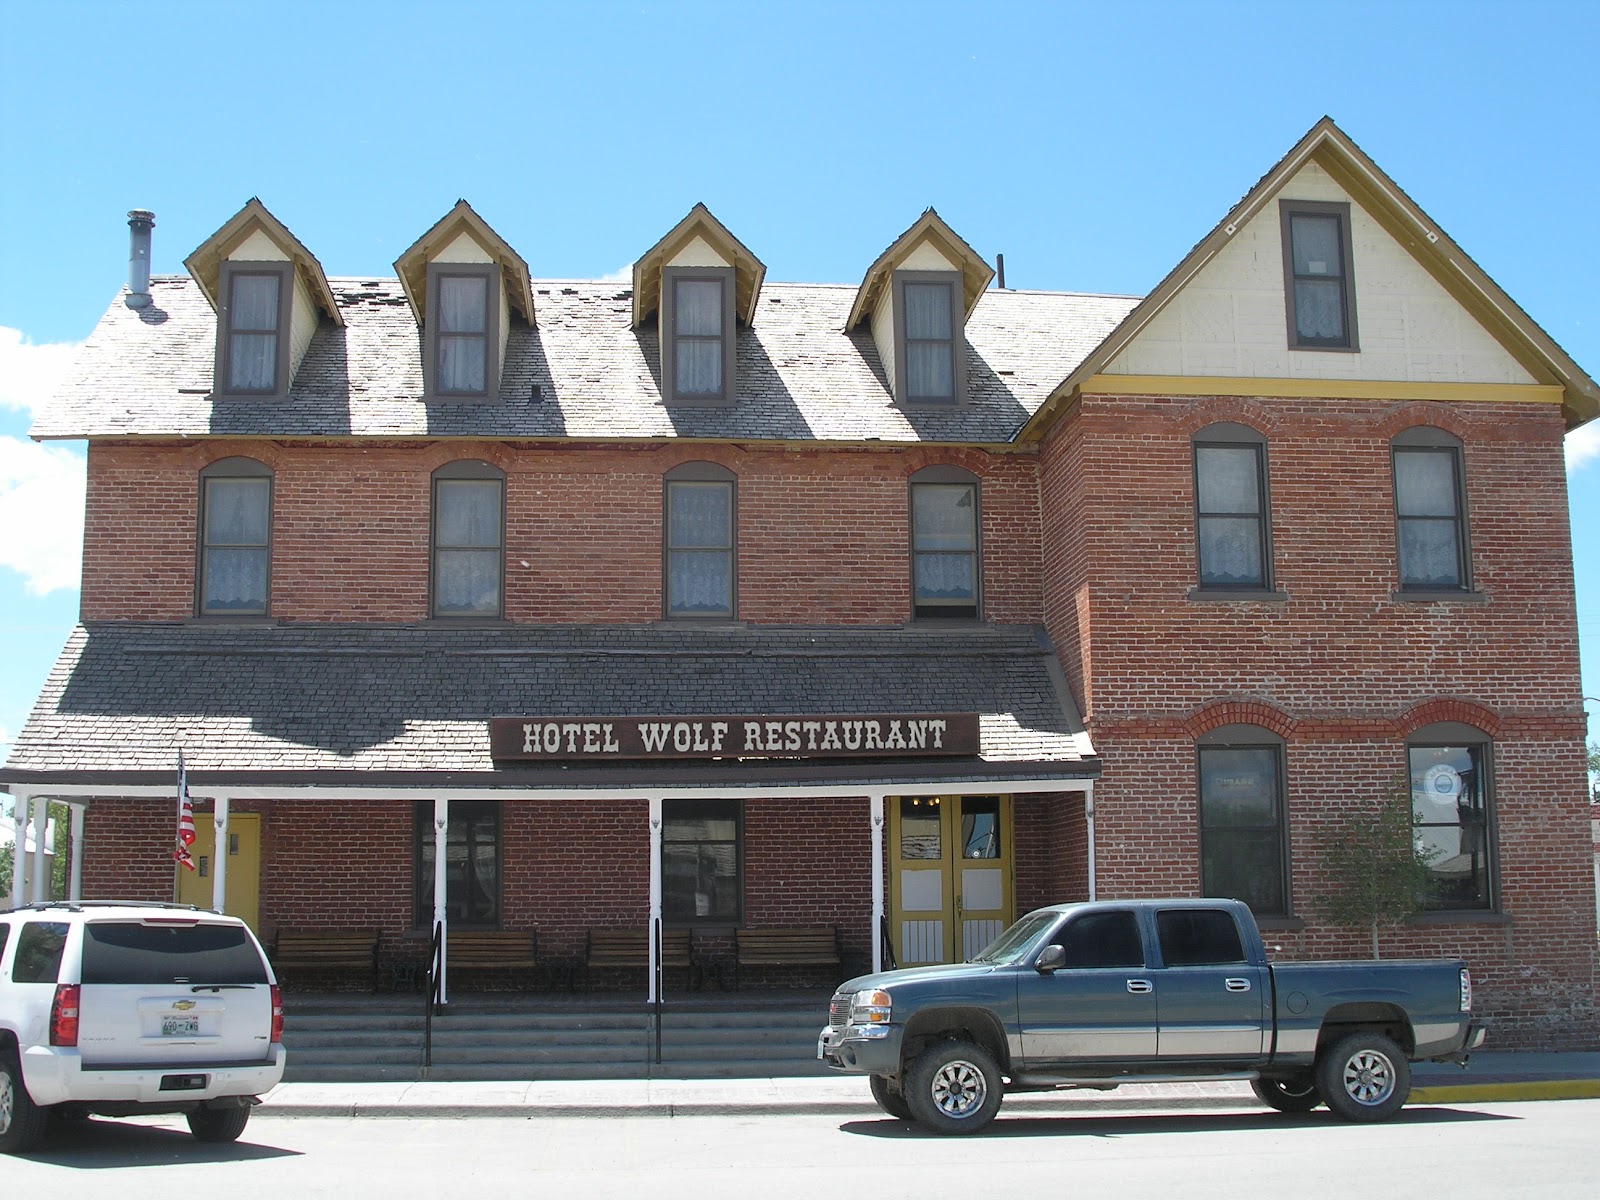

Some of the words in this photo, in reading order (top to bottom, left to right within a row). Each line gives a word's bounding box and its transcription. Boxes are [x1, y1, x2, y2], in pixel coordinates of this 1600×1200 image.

[522, 723, 620, 753] HOTEL
[637, 722, 729, 752] WOLF
[743, 719, 947, 751] RESTAURANT
